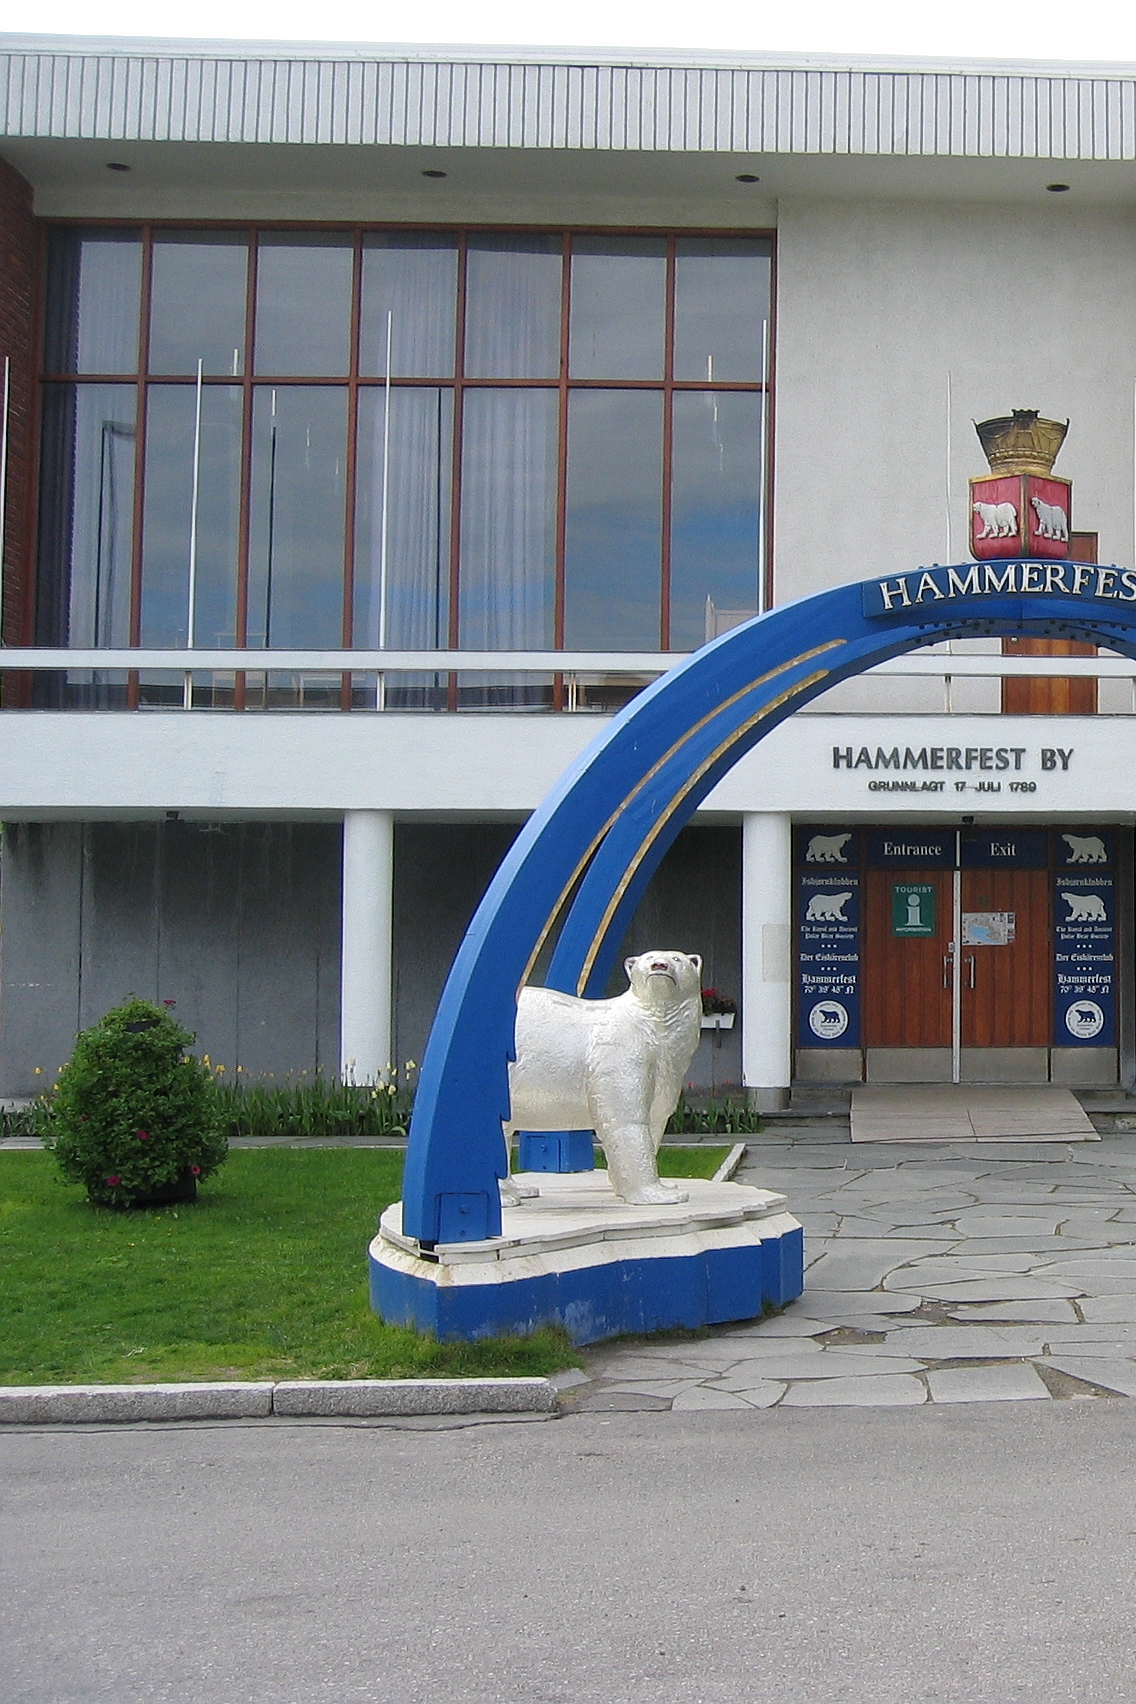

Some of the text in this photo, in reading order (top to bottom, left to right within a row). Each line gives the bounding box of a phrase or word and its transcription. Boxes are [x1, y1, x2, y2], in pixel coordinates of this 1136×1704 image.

[832, 746, 1075, 771] HAMMERFEST BY
[867, 780, 946, 792] GRUNNLAGT
[954, 781, 967, 792] 17
[975, 781, 1001, 792] JULI
[883, 841, 942, 856] Entrance
[989, 842, 1017, 857] Exit
[801, 973, 857, 985] Hammerfest
[1057, 973, 1112, 985] Hammerfest
